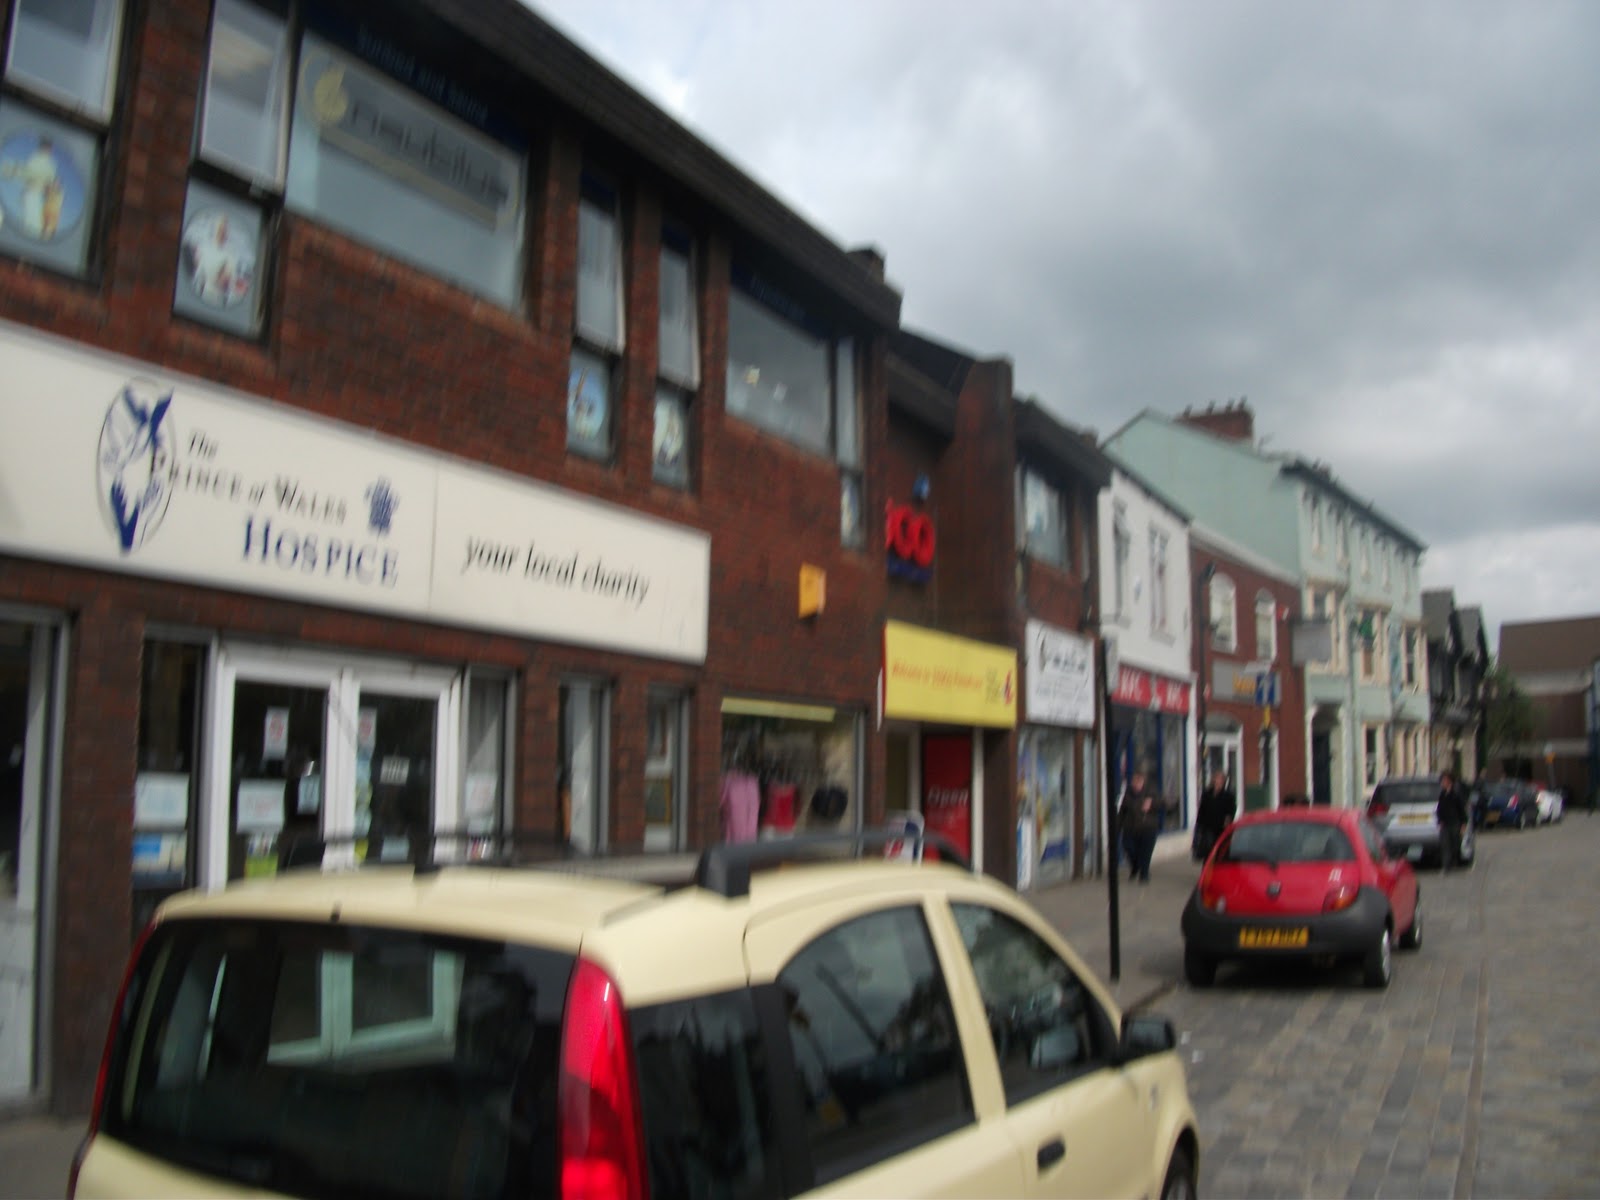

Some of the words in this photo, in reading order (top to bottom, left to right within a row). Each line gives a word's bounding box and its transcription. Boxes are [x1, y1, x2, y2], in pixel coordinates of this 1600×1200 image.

[188, 430, 219, 459] The
[248, 481, 266, 505] of
[275, 473, 348, 525] WALES
[242, 513, 399, 588] HOSPICE
[460, 535, 520, 575] your
[524, 540, 579, 589] local
[581, 556, 650, 611] charity
